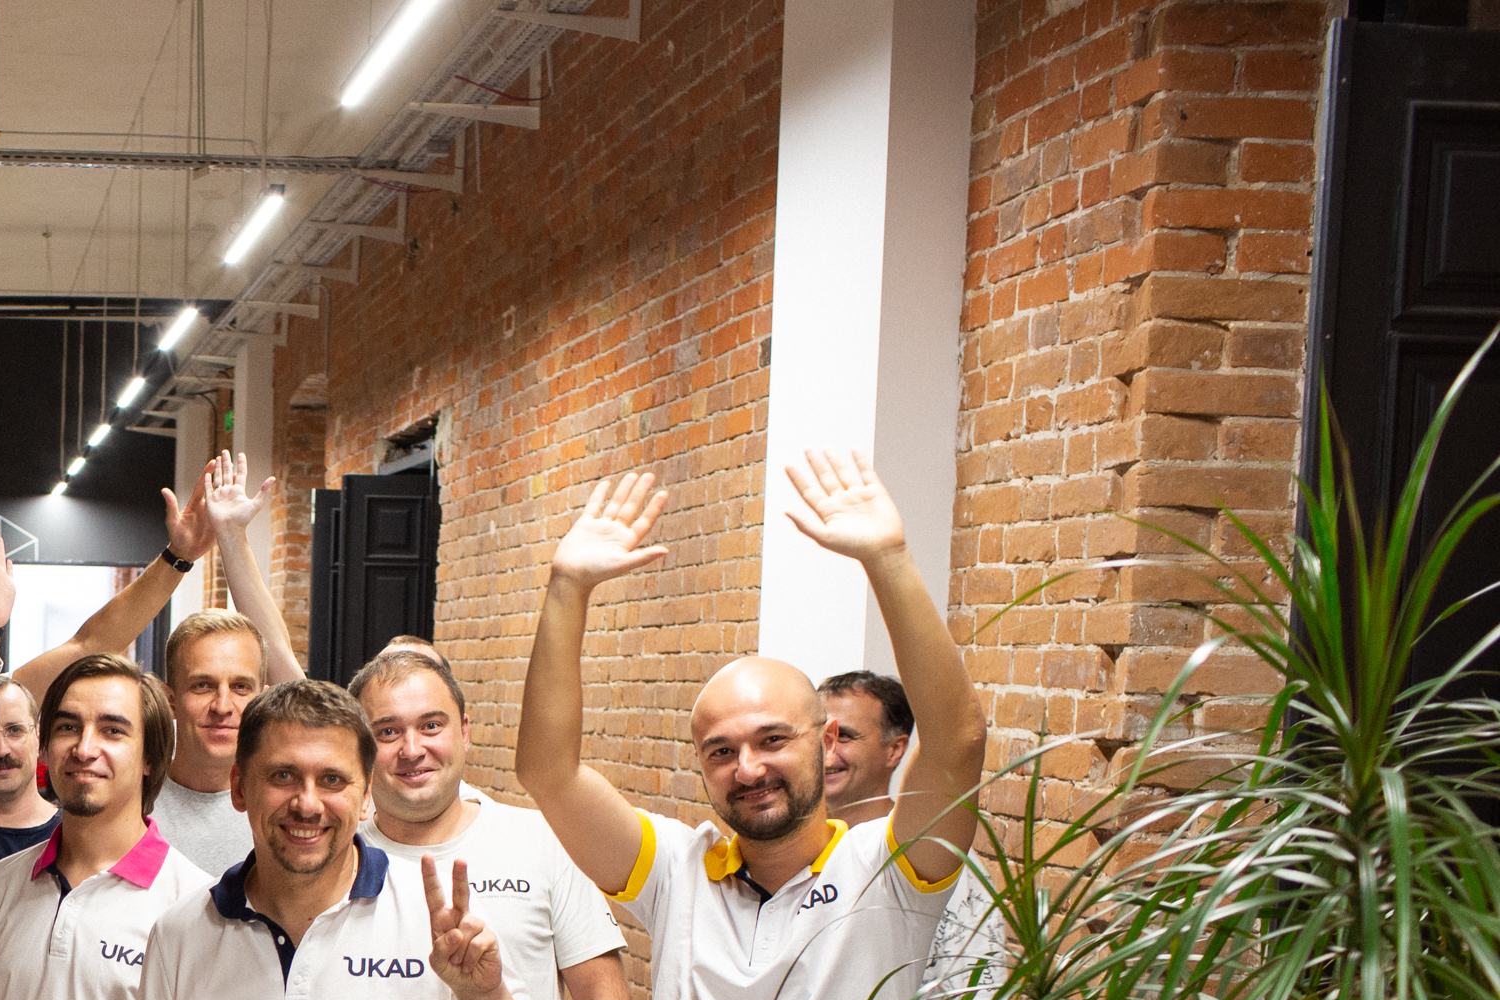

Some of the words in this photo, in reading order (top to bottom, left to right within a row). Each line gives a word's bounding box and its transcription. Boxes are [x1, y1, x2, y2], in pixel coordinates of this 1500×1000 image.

[470, 879, 530, 893] UKAD
[797, 884, 838, 915] AD
[100, 940, 145, 966] UKA
[343, 956, 425, 978] UKAD
